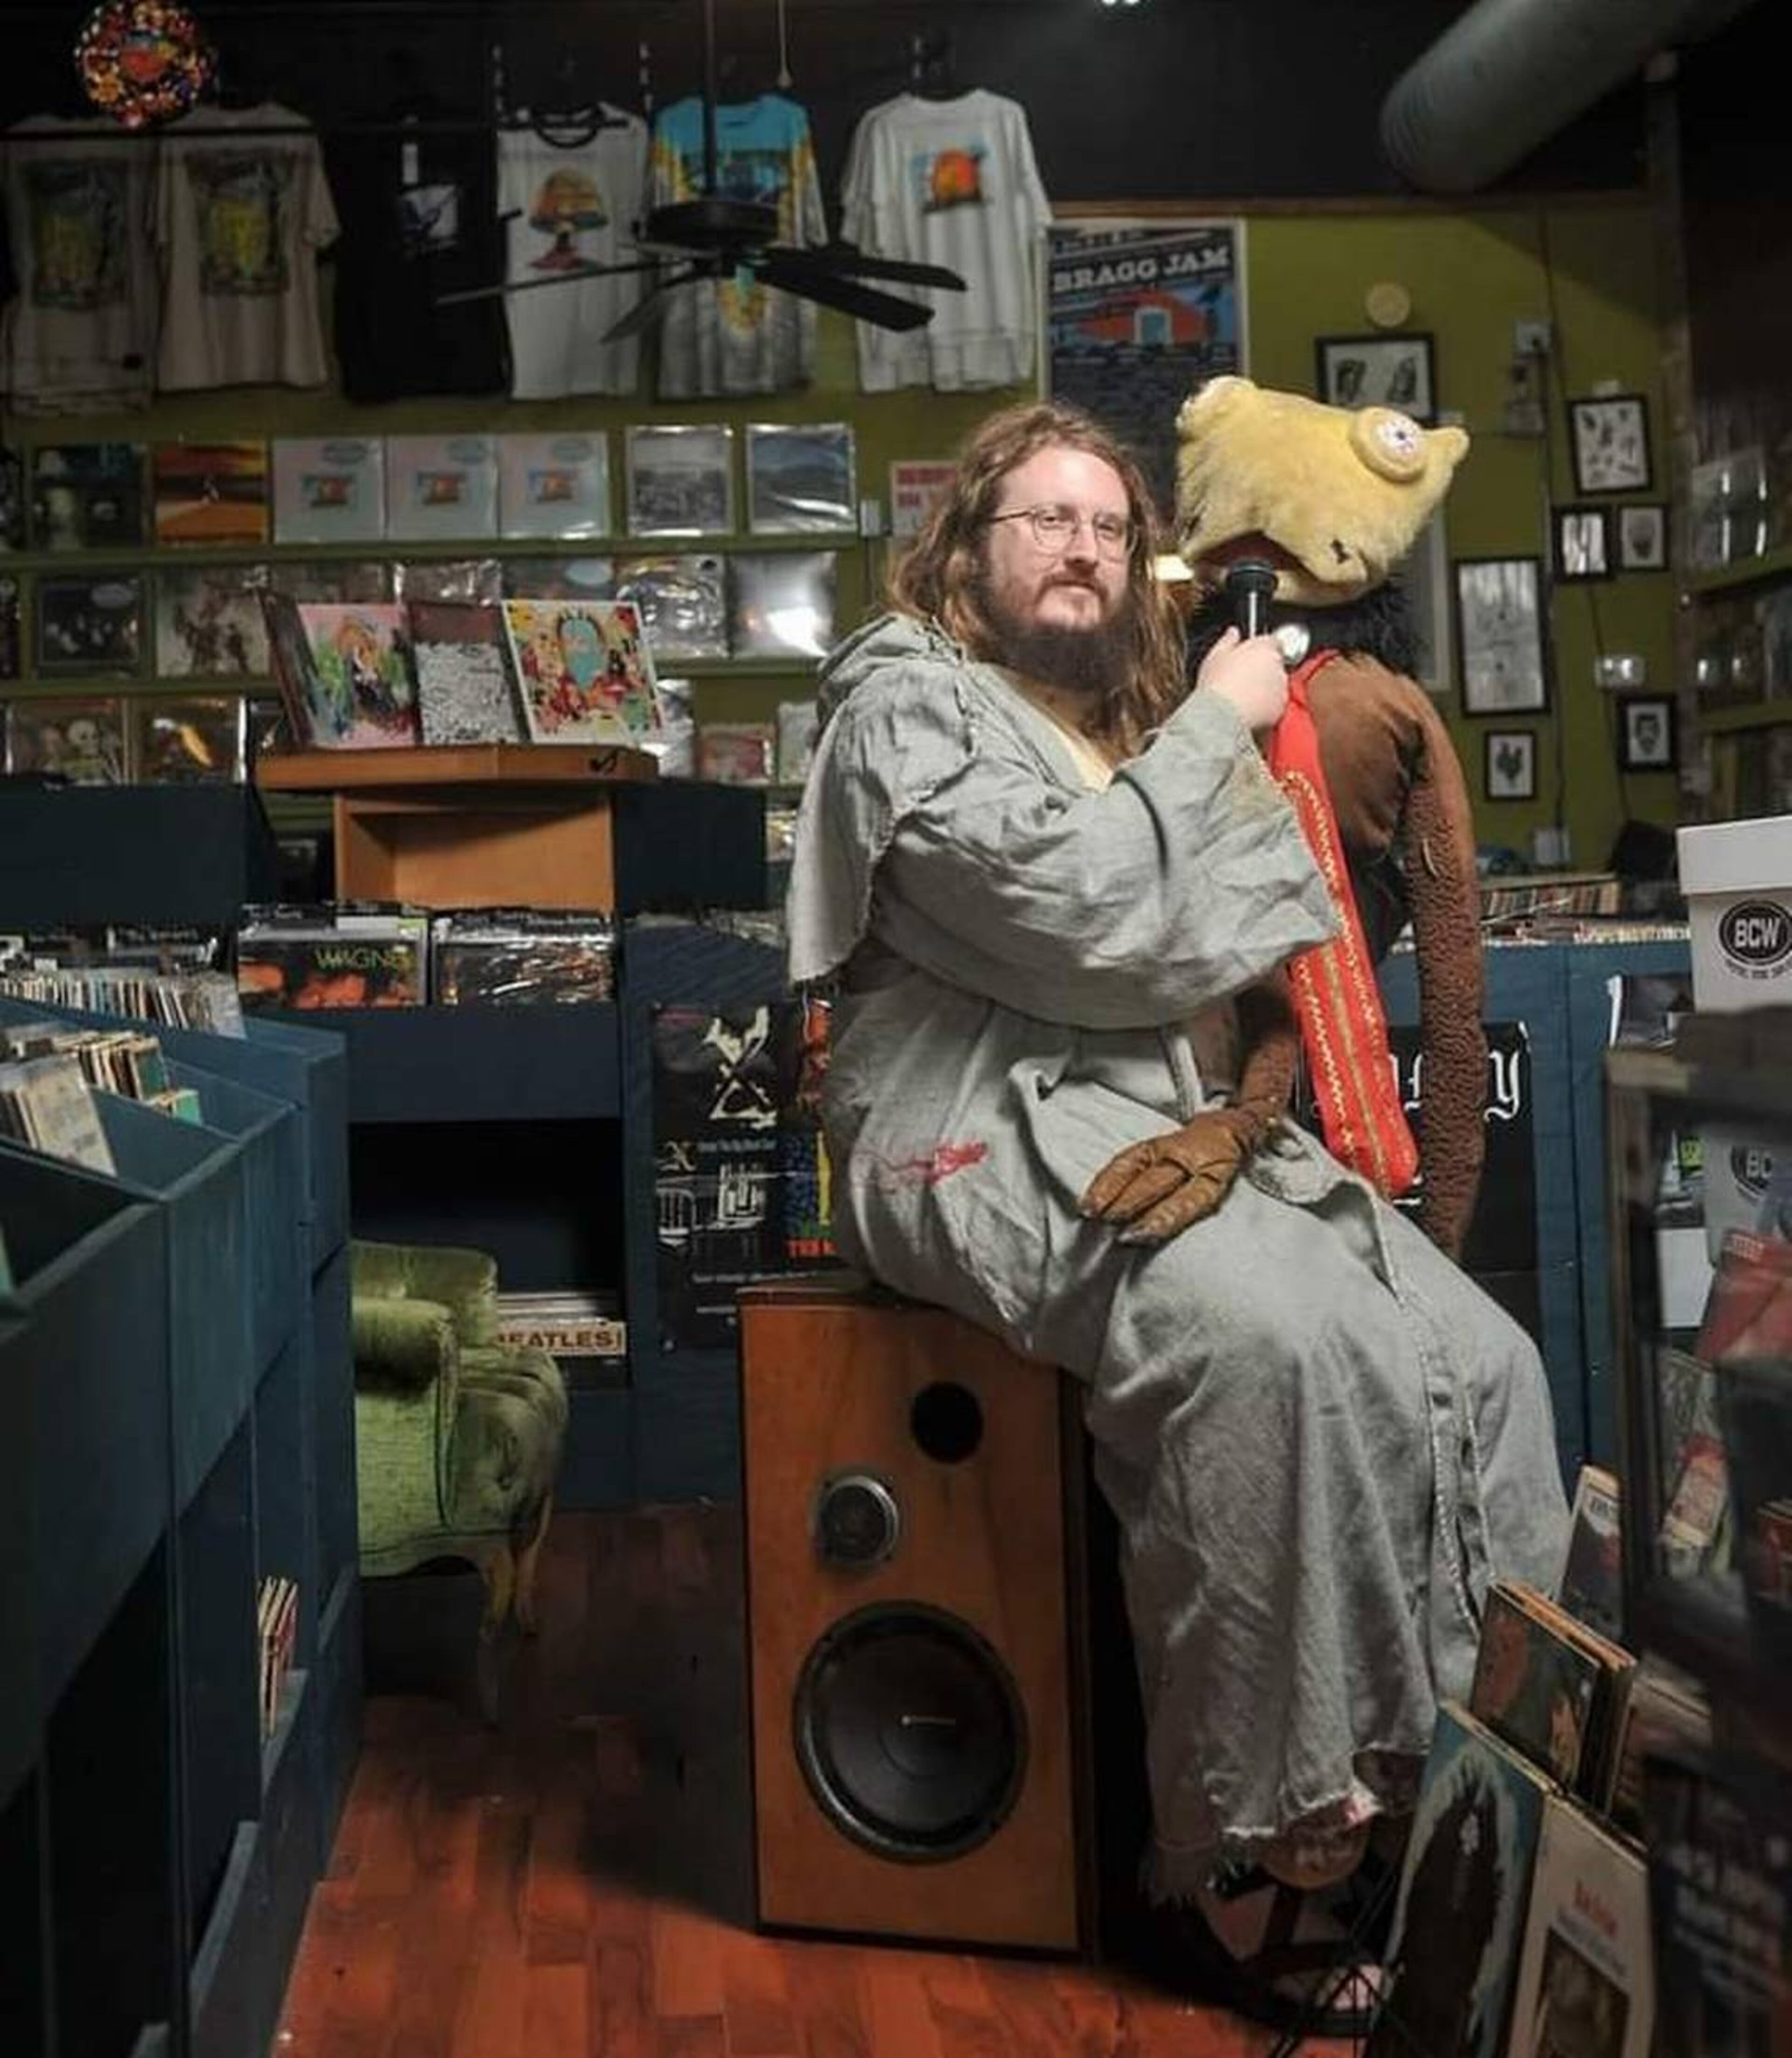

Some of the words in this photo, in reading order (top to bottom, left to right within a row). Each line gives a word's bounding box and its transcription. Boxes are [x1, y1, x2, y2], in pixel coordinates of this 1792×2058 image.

[1053, 258, 1158, 292] BRAGG
[1163, 246, 1230, 274] JAM
[1735, 918, 1780, 948] BCW
